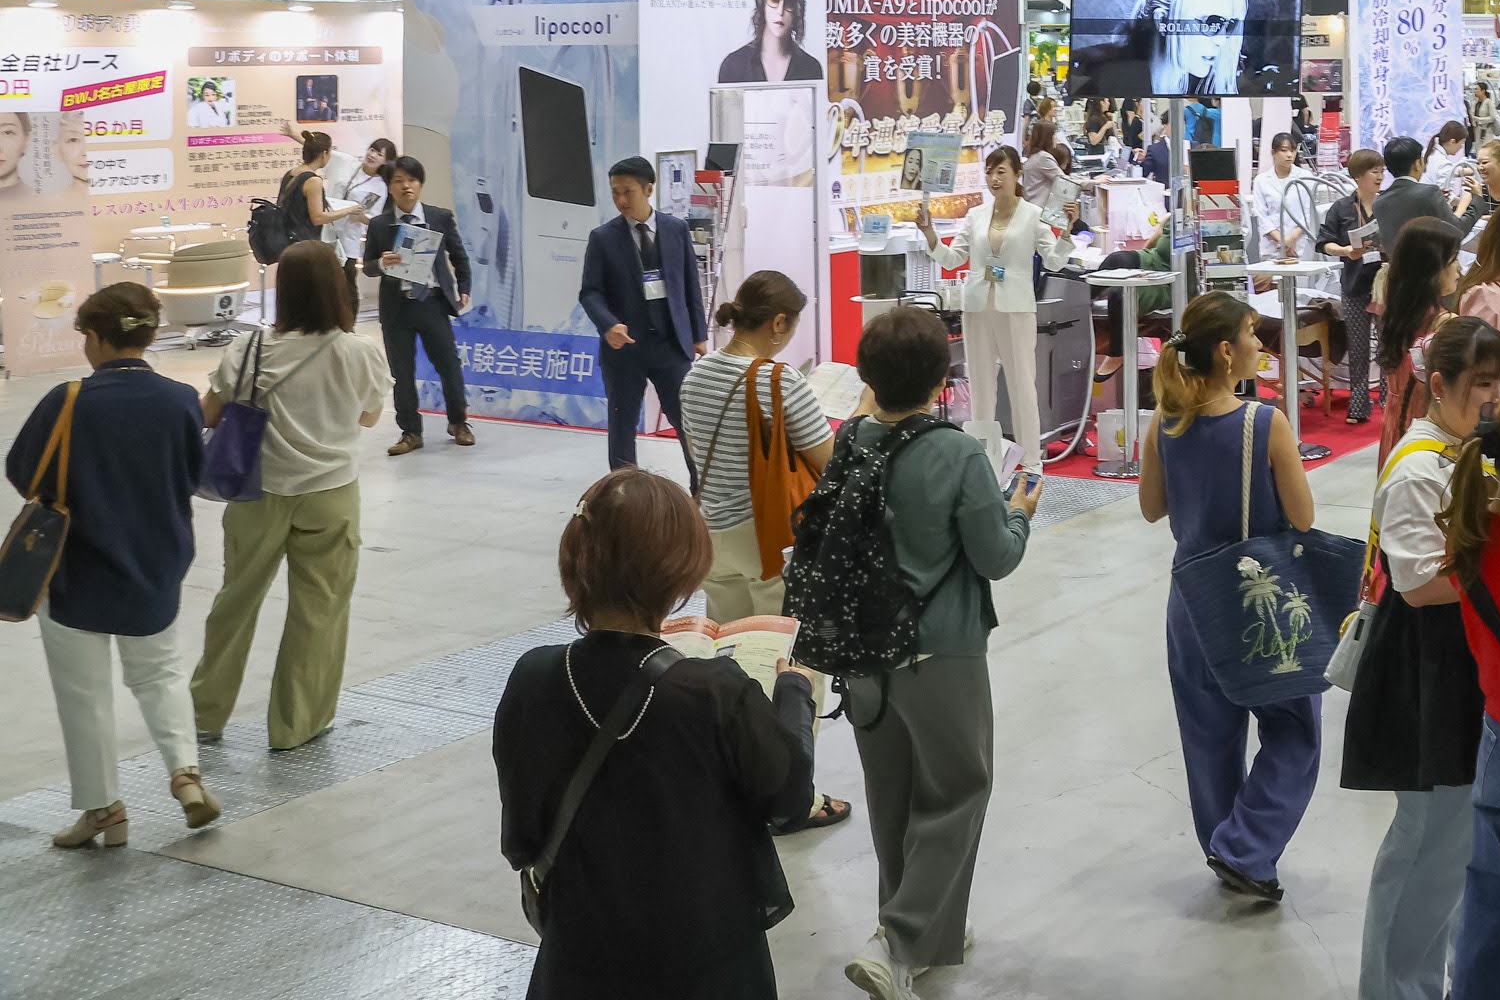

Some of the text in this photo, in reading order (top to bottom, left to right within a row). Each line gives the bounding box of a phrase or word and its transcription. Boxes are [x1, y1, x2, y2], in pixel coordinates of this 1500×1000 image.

[535, 13, 611, 42] lipocool
[1158, 21, 1221, 33] ROLANDが
[863, 53, 942, 84] 賞を受賞！
